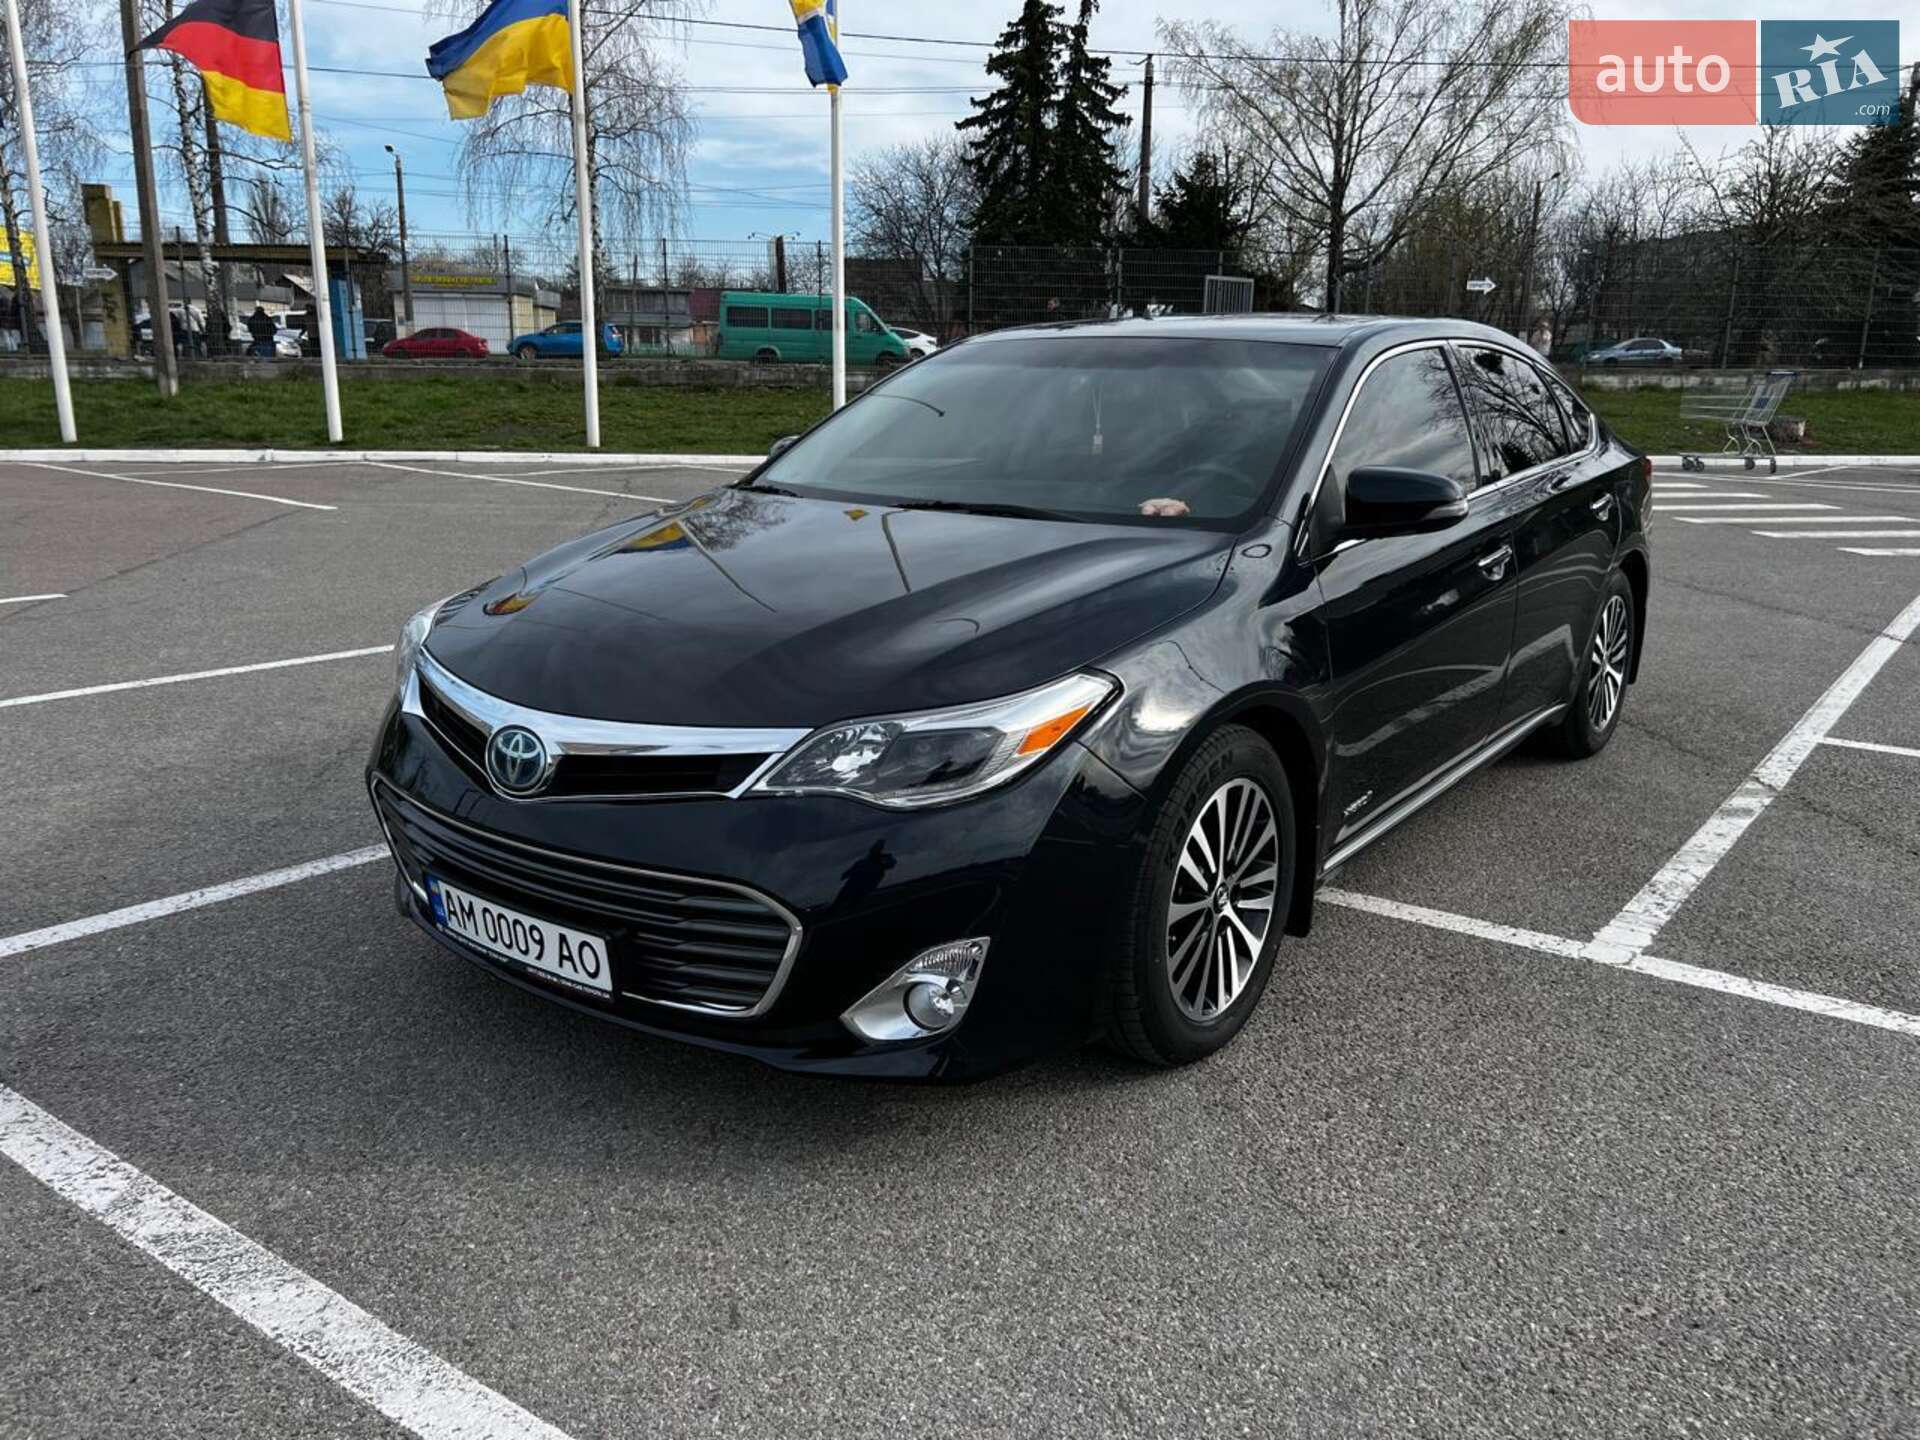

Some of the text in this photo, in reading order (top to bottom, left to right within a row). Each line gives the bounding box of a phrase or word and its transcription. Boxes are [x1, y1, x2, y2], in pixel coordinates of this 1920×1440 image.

[444, 889, 479, 936] AM
[482, 907, 545, 961] 0009
[558, 932, 601, 980] AO
